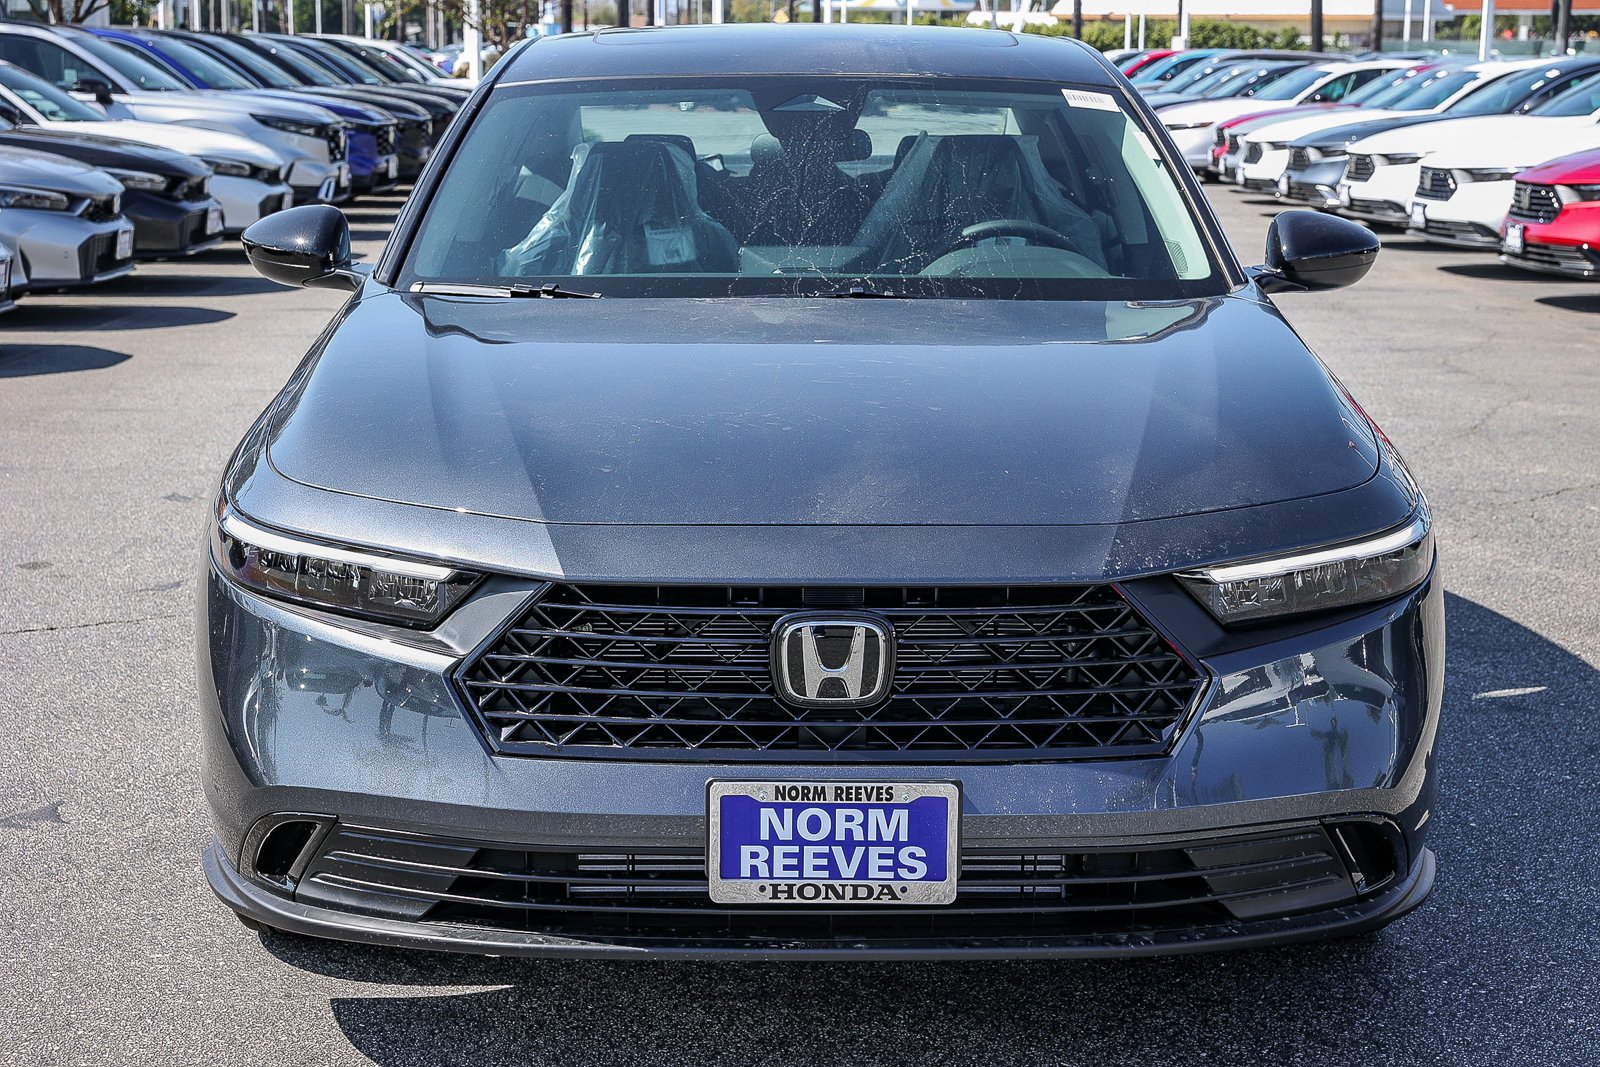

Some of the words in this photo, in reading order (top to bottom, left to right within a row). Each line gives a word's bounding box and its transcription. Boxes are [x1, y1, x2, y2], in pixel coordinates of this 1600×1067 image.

[774, 785, 827, 802] NORM
[833, 786, 894, 802] REEVES
[759, 807, 909, 842] NORM
[740, 845, 928, 880] REEVES
[768, 883, 902, 901] HONDA
